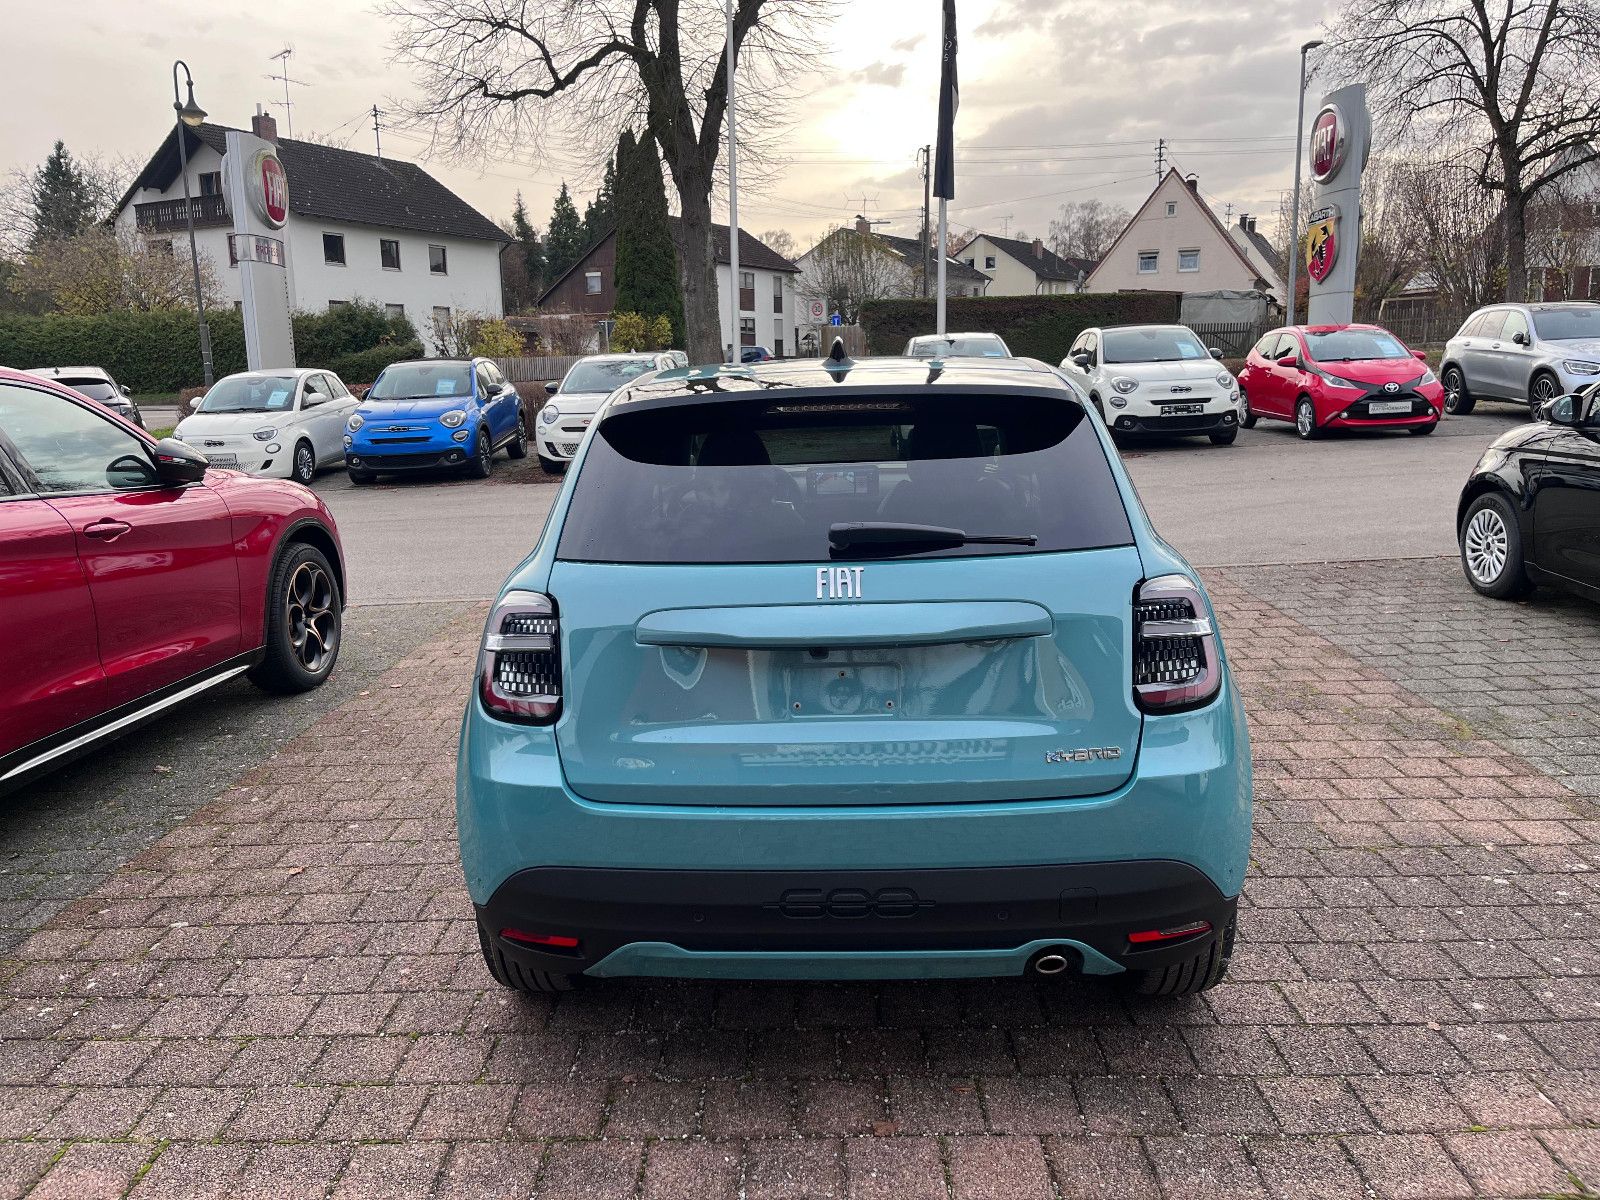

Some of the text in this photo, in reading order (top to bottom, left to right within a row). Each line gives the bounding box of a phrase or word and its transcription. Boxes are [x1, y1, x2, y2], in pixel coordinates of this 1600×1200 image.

[1313, 124, 1334, 163] FIAT
[1310, 208, 1334, 222] ABARTH
[816, 566, 865, 600] FIAT
[1045, 745, 1121, 763] HYBRID
[778, 887, 920, 920] 600
